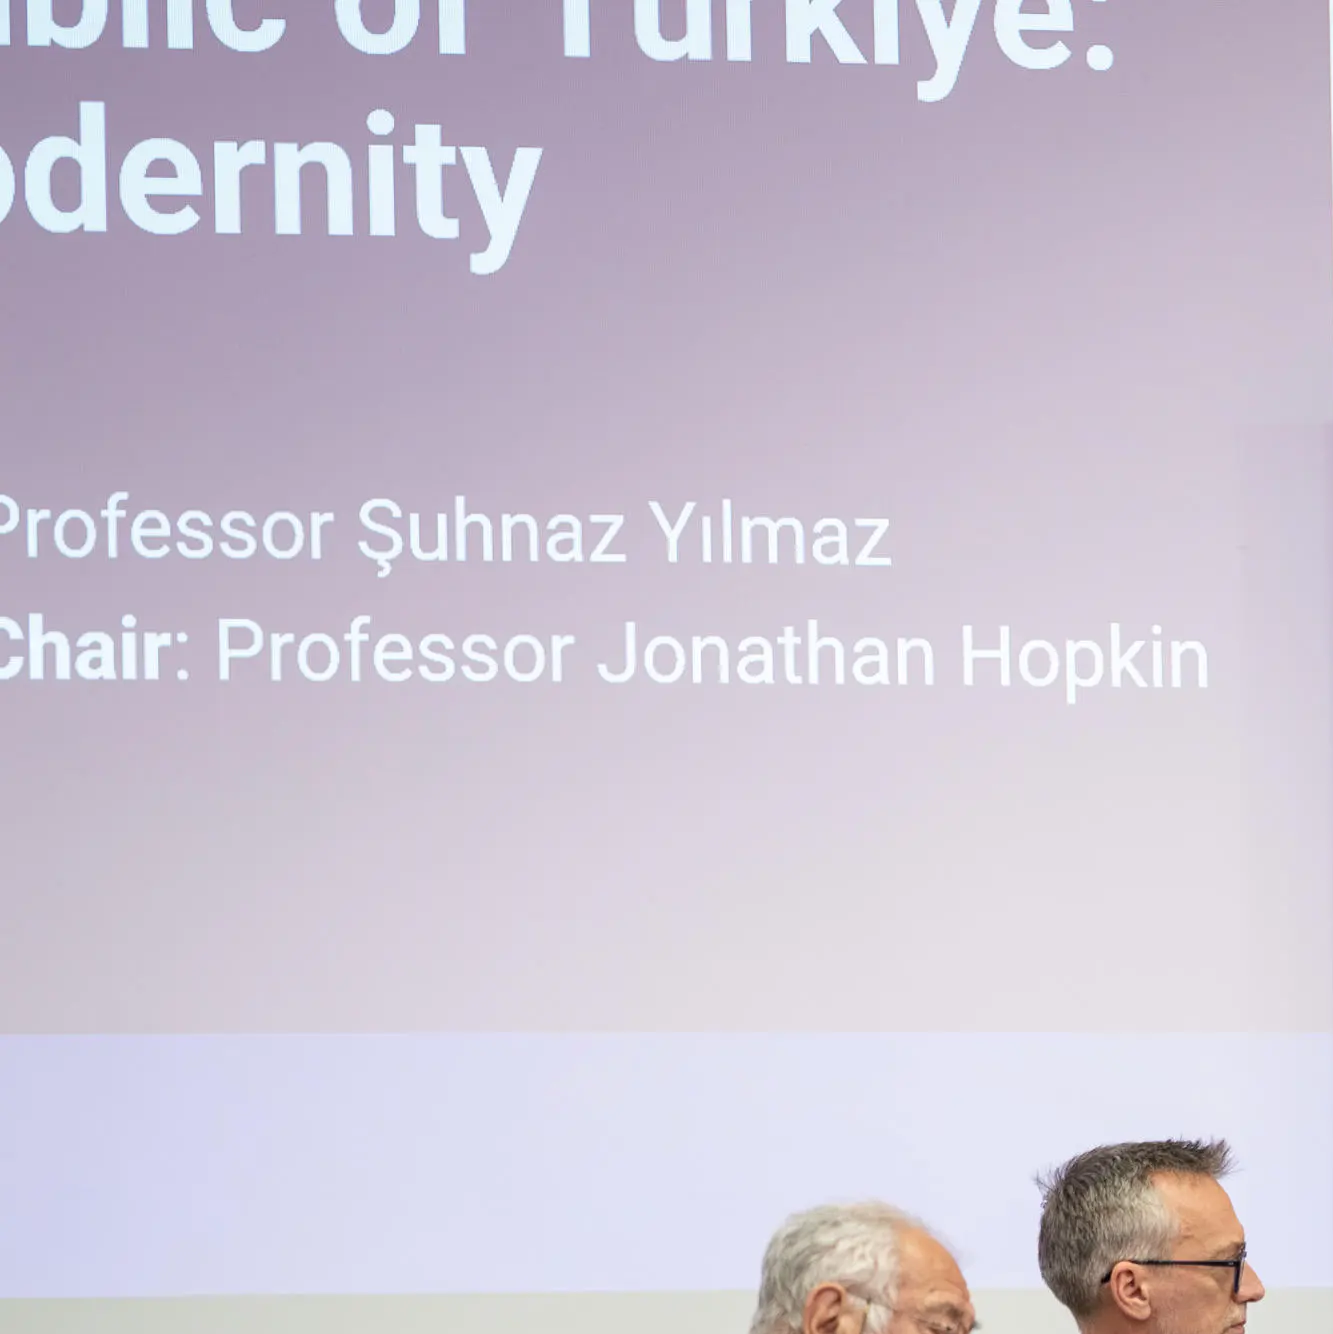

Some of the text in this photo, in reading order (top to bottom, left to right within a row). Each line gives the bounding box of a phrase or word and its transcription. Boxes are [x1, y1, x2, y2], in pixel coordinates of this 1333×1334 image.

[0, 101, 544, 276] dernity
[358, 495, 627, 578] Şuhnaz
[648, 499, 892, 566] Yılmaz
[219, 615, 575, 682] Professor
[597, 619, 934, 685] Jonathan
[962, 622, 1208, 705] Hopkin
